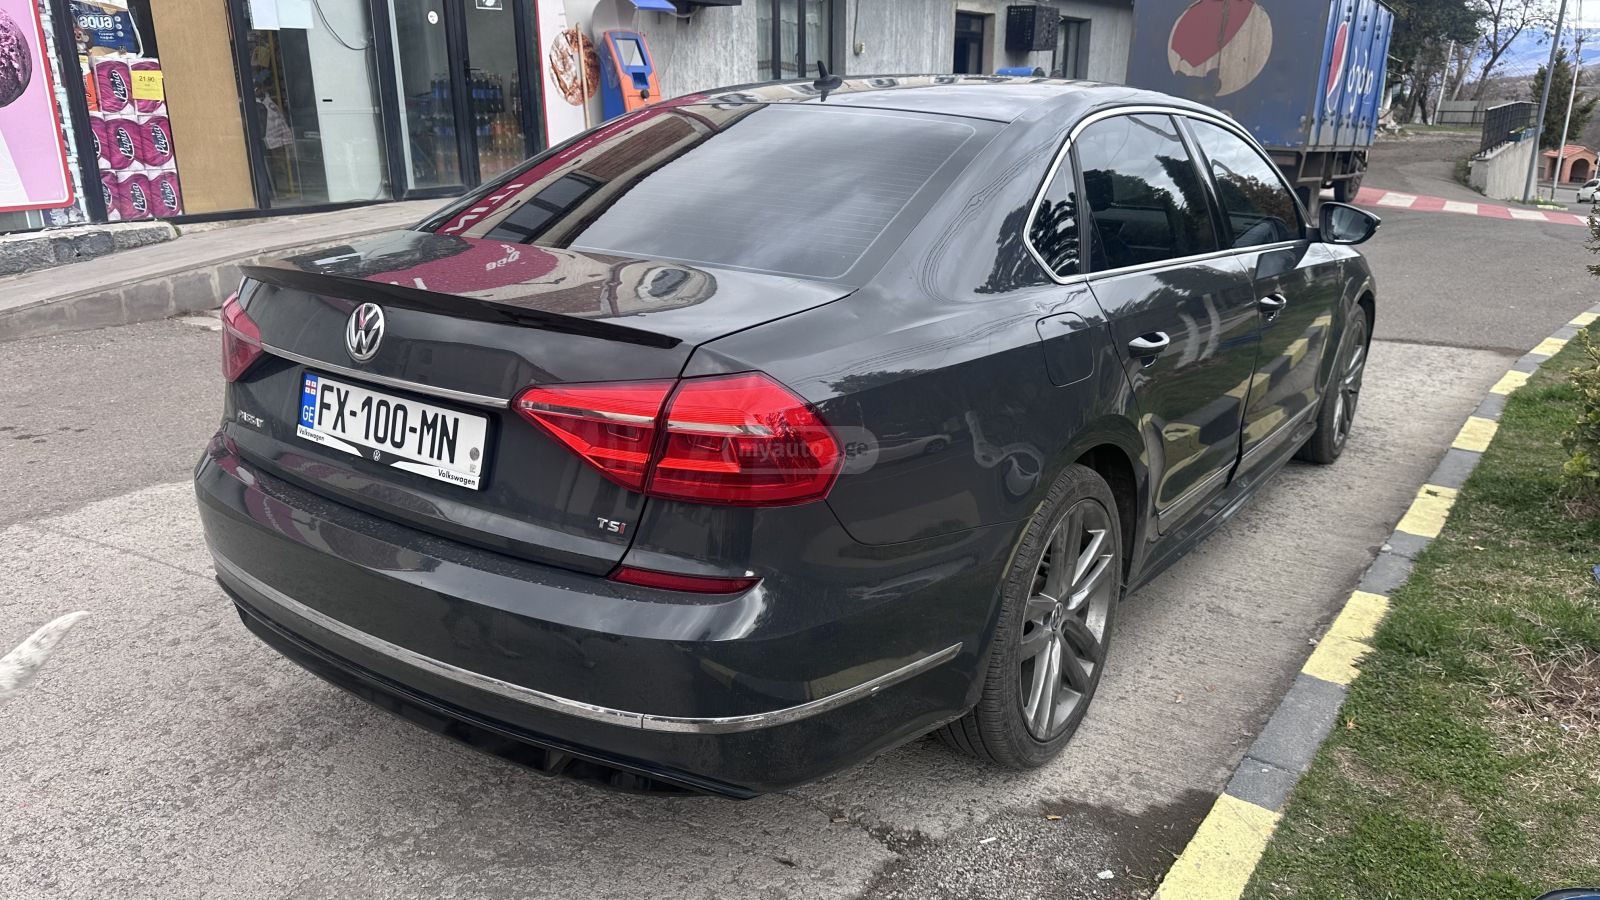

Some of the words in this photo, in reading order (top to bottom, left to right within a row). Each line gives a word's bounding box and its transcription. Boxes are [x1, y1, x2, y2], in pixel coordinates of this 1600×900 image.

[302, 405, 315, 423] GE
[318, 383, 459, 464] FX-100-MN
[298, 428, 325, 442] Volkswagen
[438, 468, 476, 486] Volkswagen
